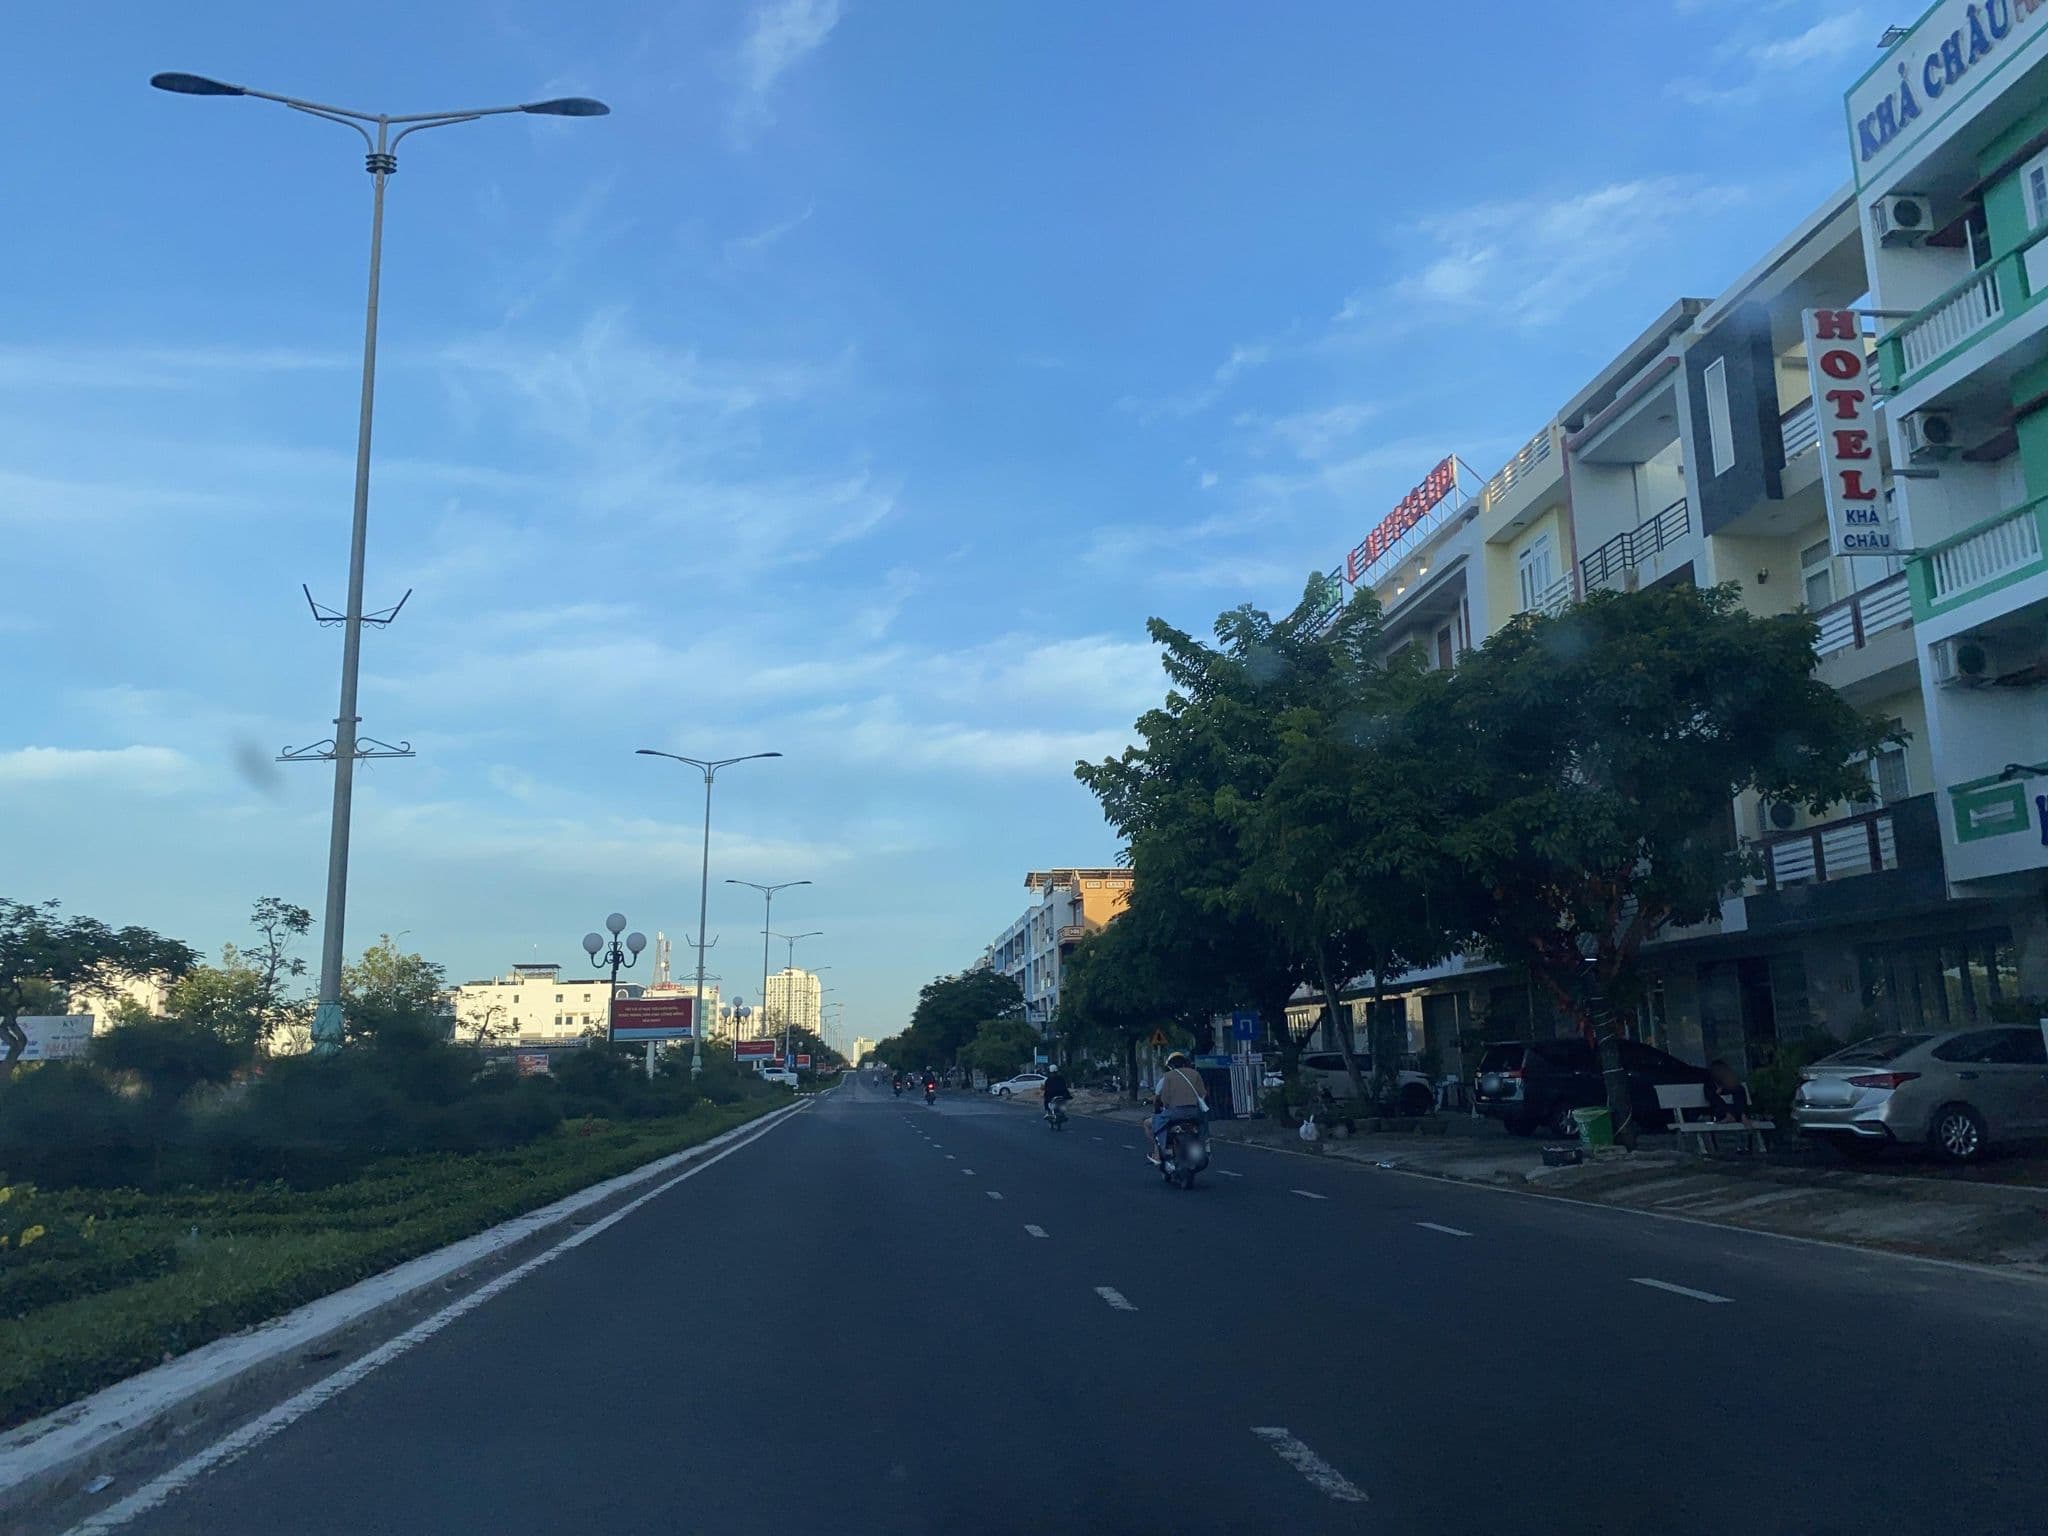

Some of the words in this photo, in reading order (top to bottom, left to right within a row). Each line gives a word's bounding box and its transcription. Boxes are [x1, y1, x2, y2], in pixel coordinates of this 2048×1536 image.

[1858, 62, 1921, 161] KHẢ
[1924, 0, 2009, 98] CHÂU
[1814, 310, 1876, 500] HOTEL
[1843, 531, 1890, 548] CHÂU
[1846, 505, 1880, 523] KHẢ
